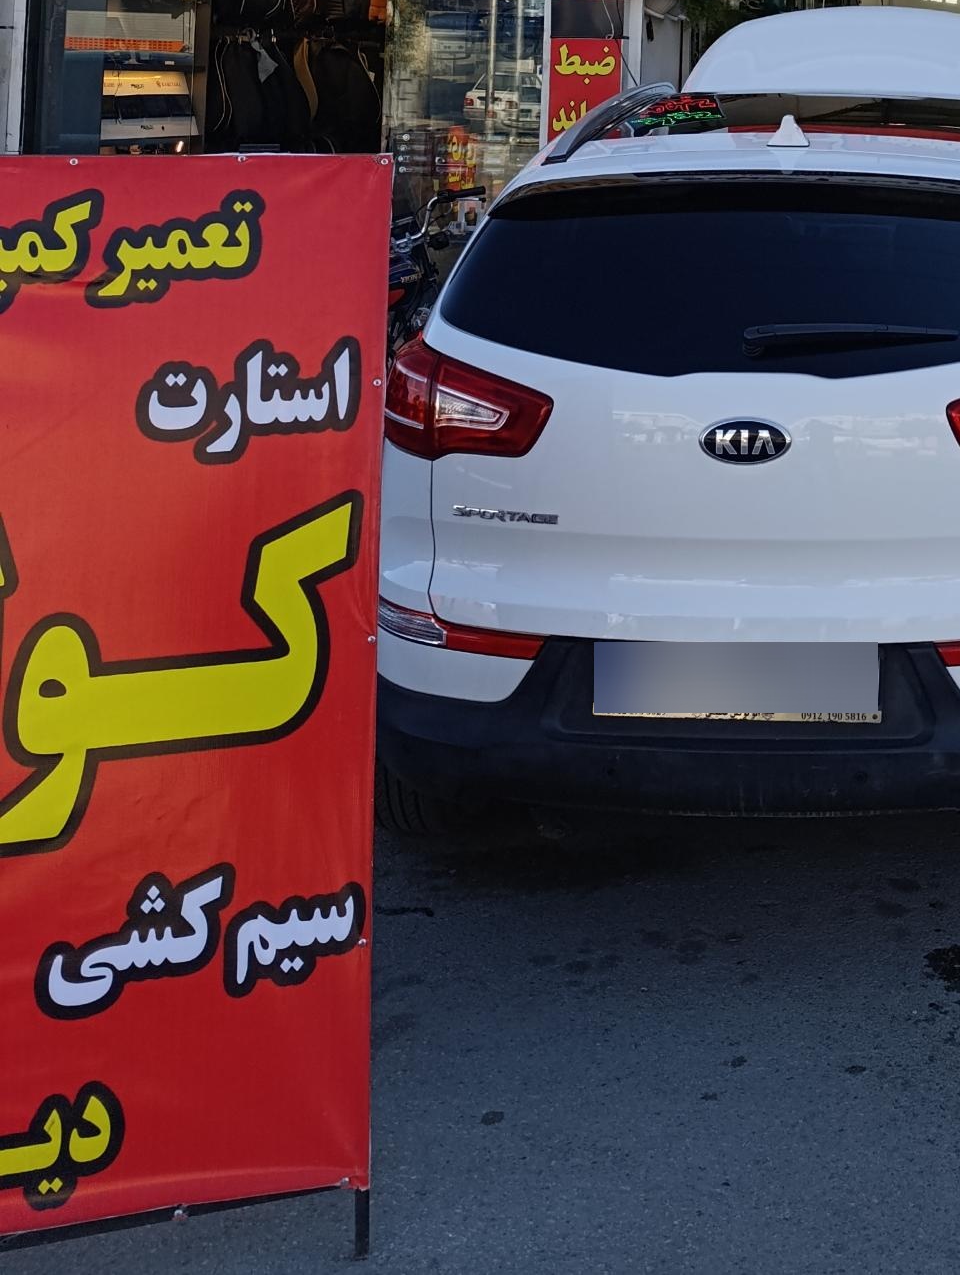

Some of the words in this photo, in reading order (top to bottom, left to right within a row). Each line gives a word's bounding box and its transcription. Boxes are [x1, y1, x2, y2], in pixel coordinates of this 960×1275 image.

[555, 44, 616, 85] ضبط
[91, 196, 257, 302] تعمیر
[142, 342, 355, 458] استارت
[714, 429, 777, 455] KIA
[41, 868, 229, 1013] کشی
[230, 888, 360, 992] سیم
